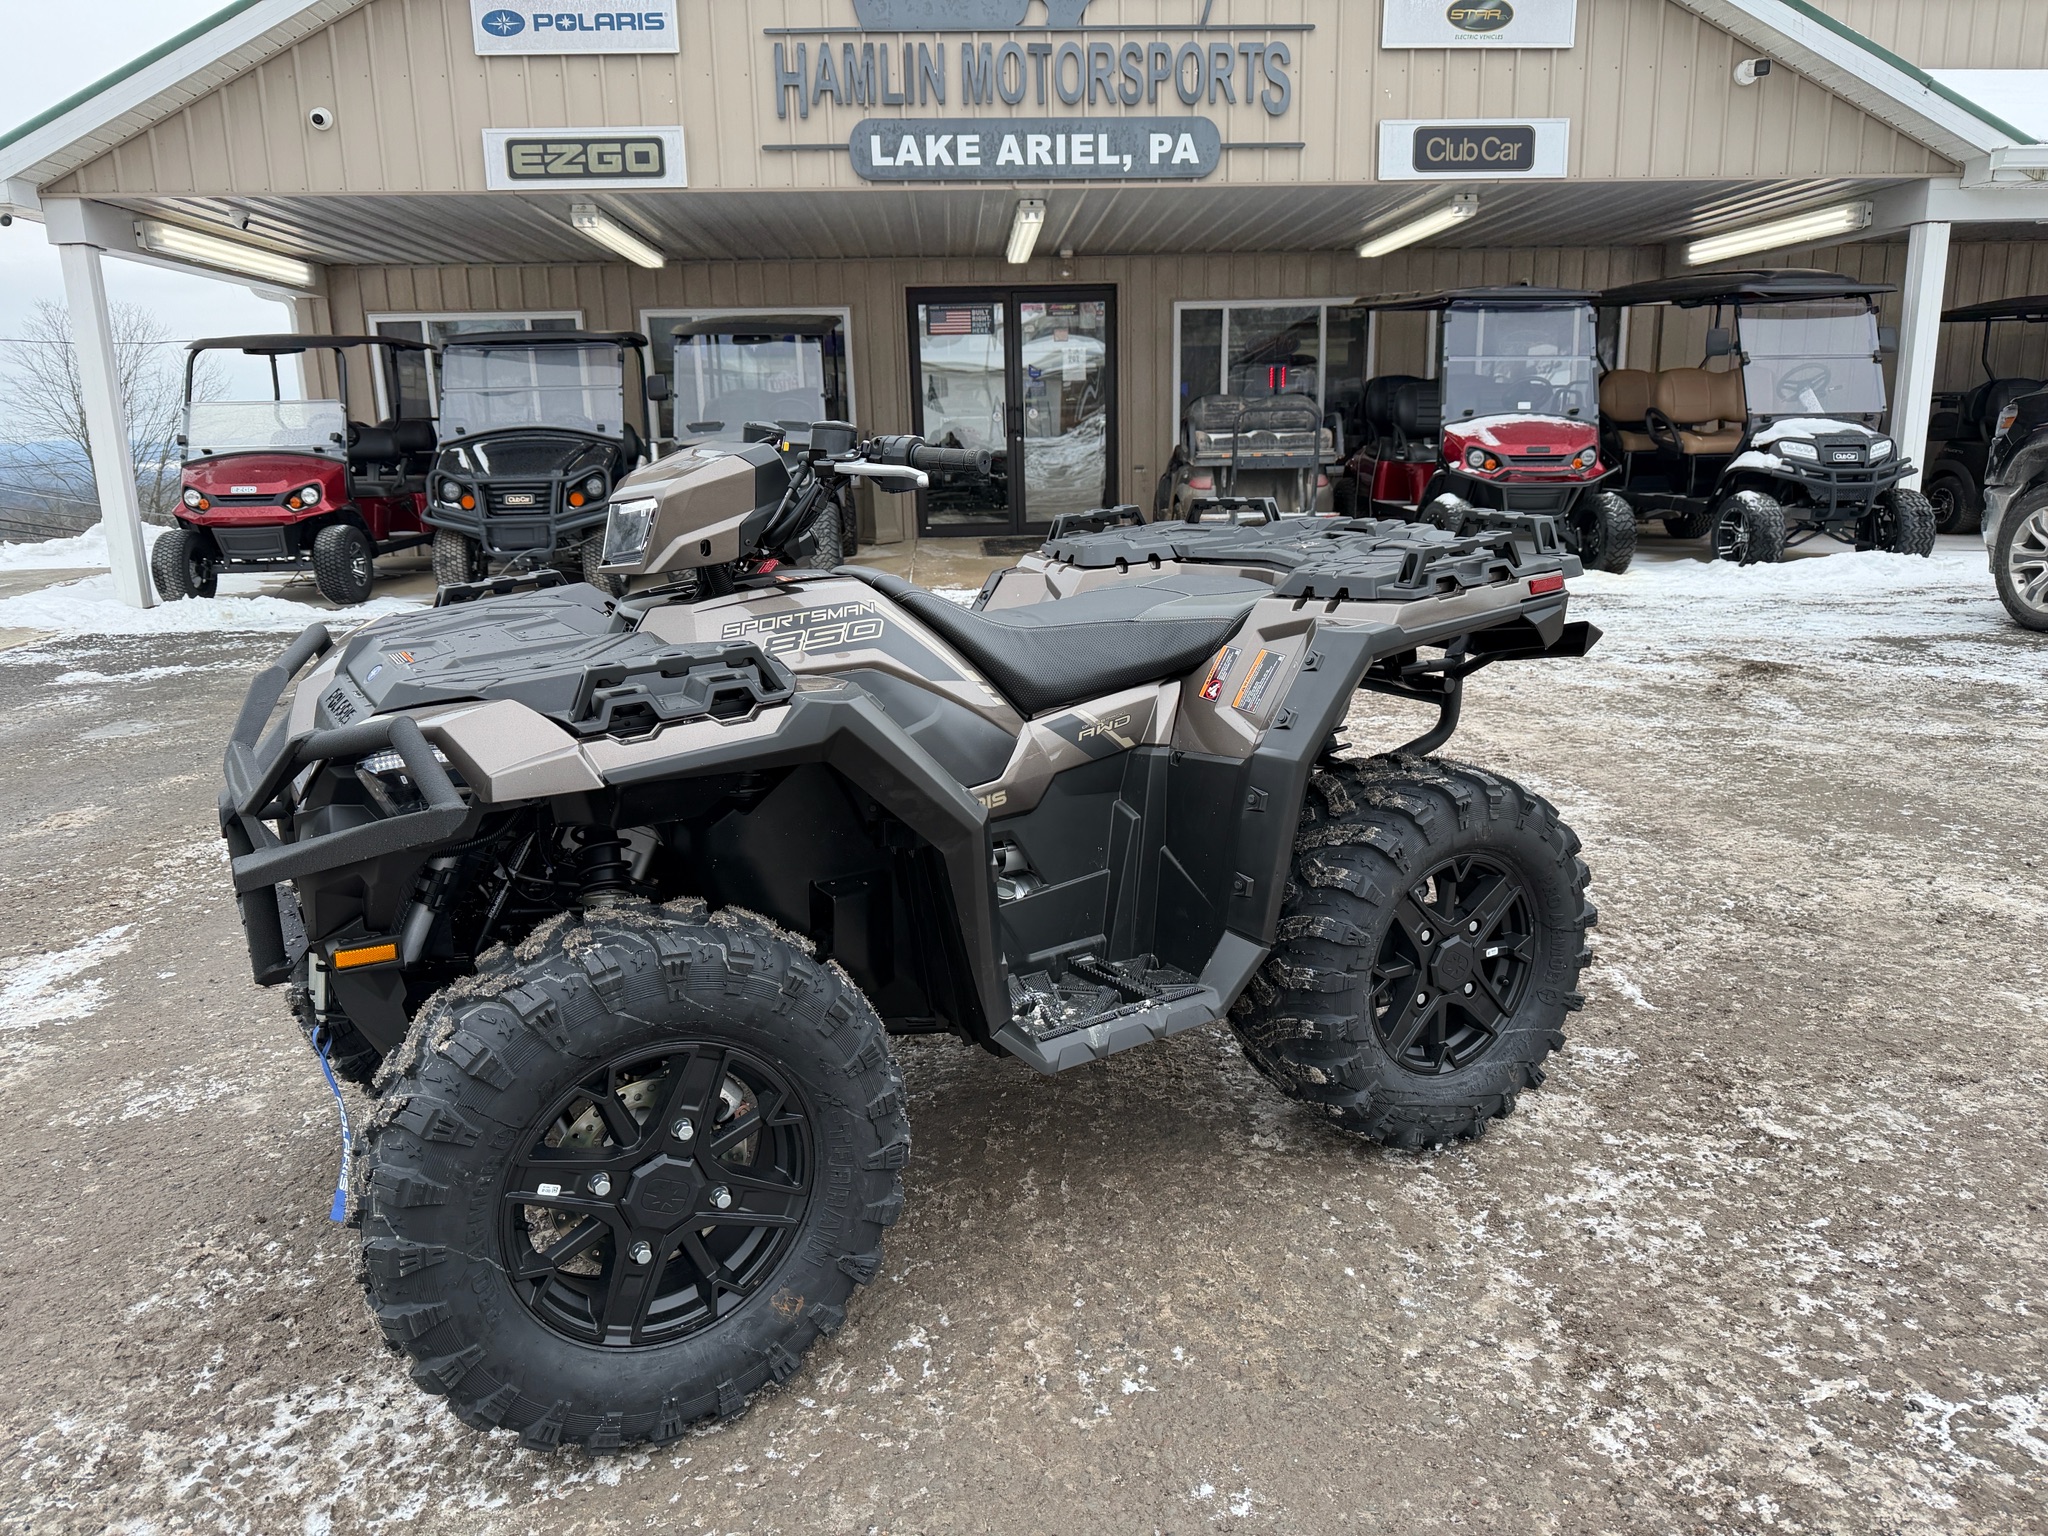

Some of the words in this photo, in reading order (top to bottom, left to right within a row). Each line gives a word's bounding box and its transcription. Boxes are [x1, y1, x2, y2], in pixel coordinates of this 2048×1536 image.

[533, 12, 665, 31] POLARIS
[1450, 9, 1501, 20] STAR
[774, 42, 945, 118] HAMLIN
[962, 41, 1291, 116] MOTORSPORTS
[511, 143, 660, 175] EZGO
[870, 135, 981, 166] LAKE
[996, 133, 1132, 172] ARIEL,
[1150, 133, 1199, 164] PA
[1426, 137, 1478, 161] Club
[1481, 136, 1522, 161] Car
[722, 601, 876, 640] SPORTSMAN
[763, 618, 884, 656] 850
[1078, 714, 1131, 741] AWD
[336, 1095, 351, 1192] POLARIS
